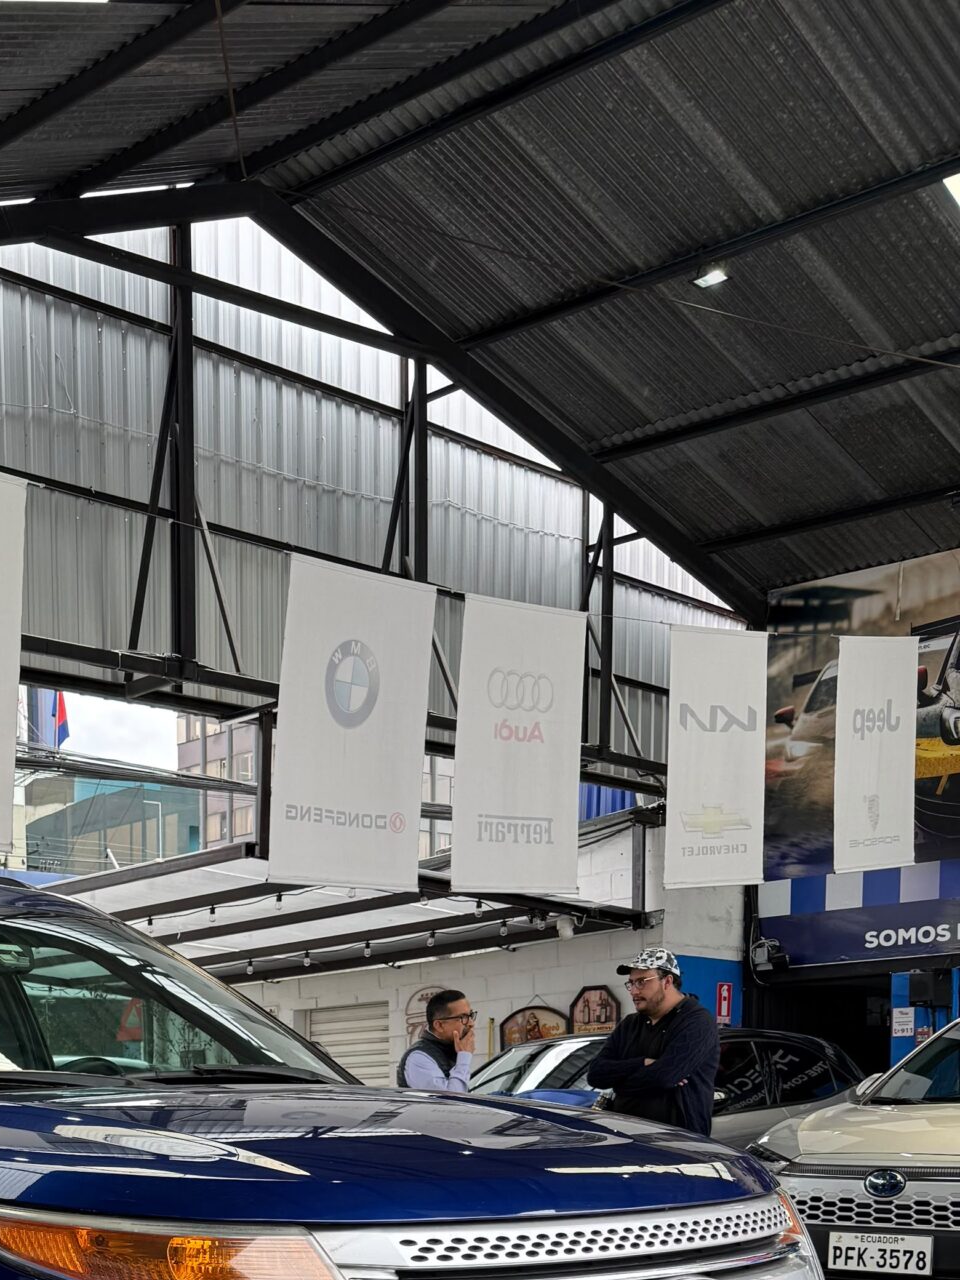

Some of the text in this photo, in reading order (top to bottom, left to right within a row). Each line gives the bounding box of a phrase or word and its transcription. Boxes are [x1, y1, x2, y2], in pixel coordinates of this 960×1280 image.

[864, 923, 951, 949] SOMOS
[860, 1234, 899, 1244] ECUADOR
[832, 1245, 927, 1271] PFK-3578
